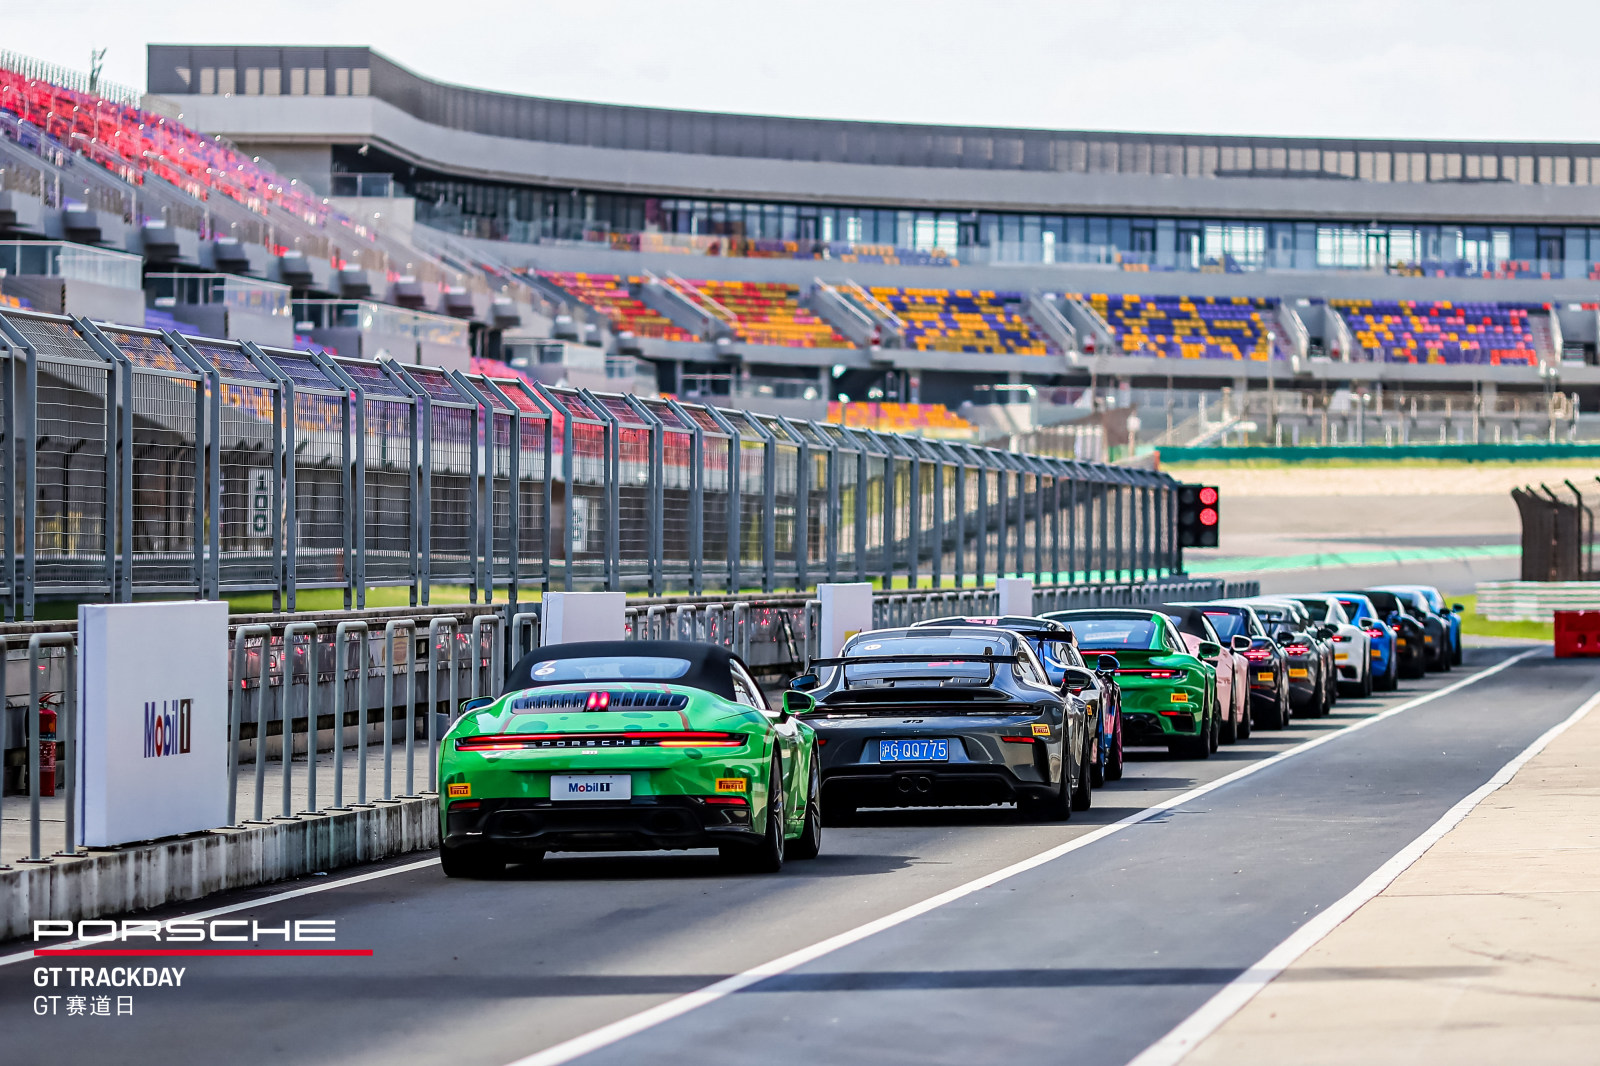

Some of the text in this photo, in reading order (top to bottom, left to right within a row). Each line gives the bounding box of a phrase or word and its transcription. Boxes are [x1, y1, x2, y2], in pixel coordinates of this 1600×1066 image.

[143, 699, 179, 759] Mobil
[541, 739, 641, 748] PORSCHE
[450, 785, 469, 795] PIRELLI
[568, 782, 611, 793] Mobil 1
